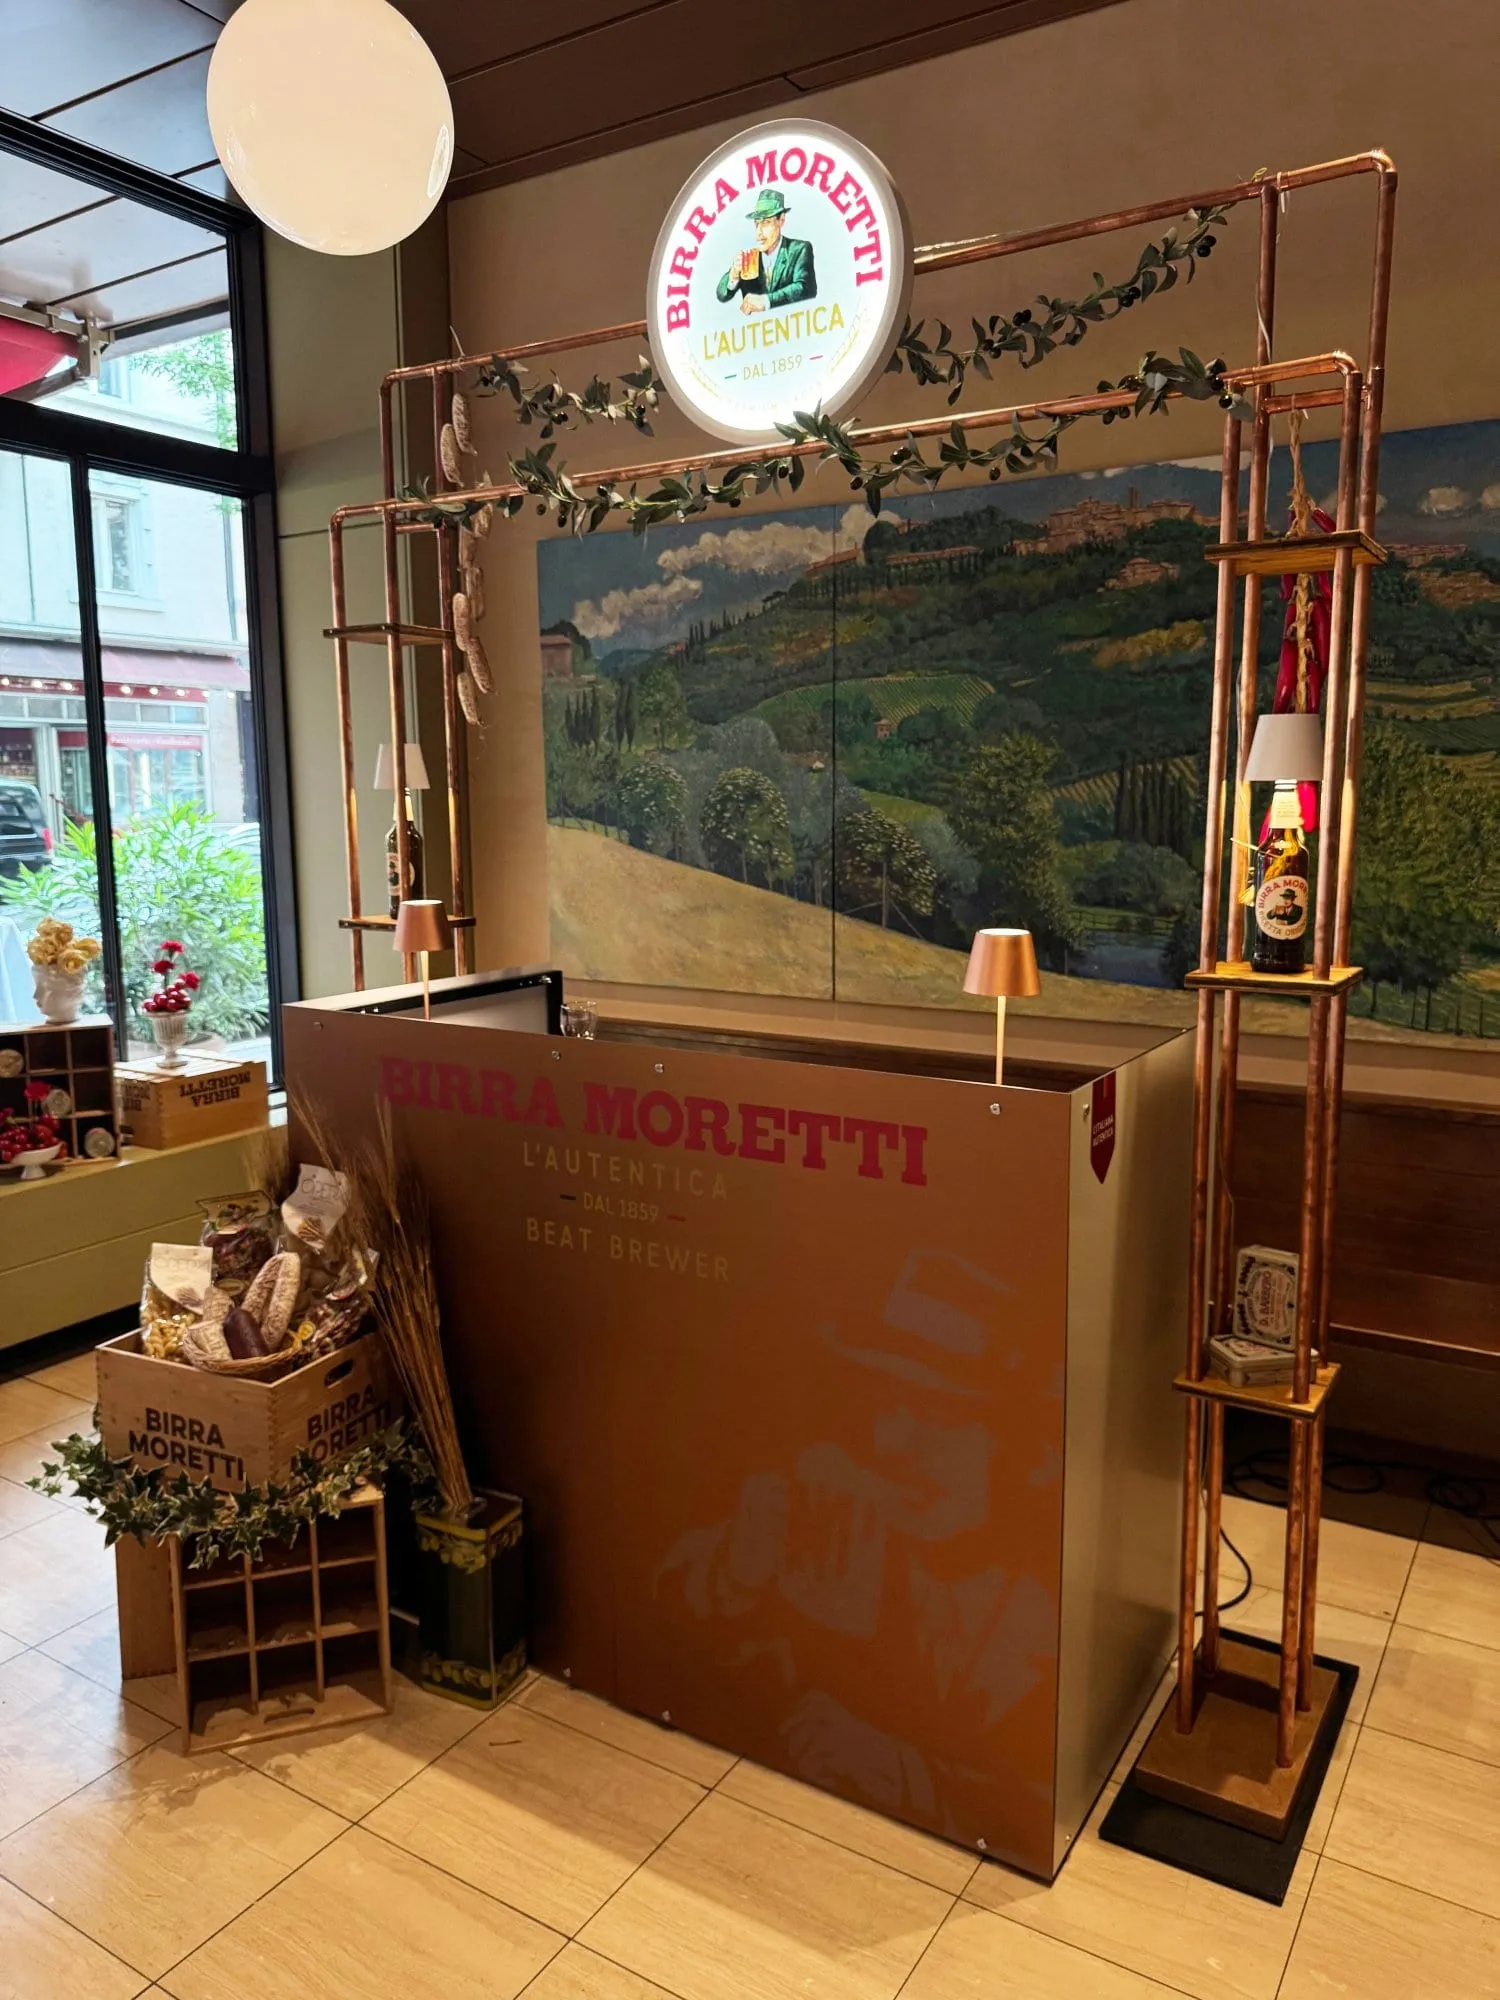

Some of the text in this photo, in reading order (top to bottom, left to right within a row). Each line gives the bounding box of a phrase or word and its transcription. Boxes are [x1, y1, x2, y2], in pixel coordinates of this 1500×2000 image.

[667, 147, 883, 332] BIRRA MORETTI
[703, 302, 845, 361] L'AUTENTICA
[743, 355, 803, 381] DAL 1859
[179, 1071, 251, 1097] MORETTI
[191, 1087, 240, 1107] BIRRA
[380, 1055, 927, 1186] BIRRA MORETTI
[523, 1141, 728, 1200] L'AUTENTICA
[583, 1191, 659, 1223] DAL 1859
[526, 1217, 729, 1281] BEAT BREWER
[146, 1407, 225, 1448] BIRRA
[308, 1384, 374, 1441] BIRRA
[129, 1430, 244, 1481] MORETTI
